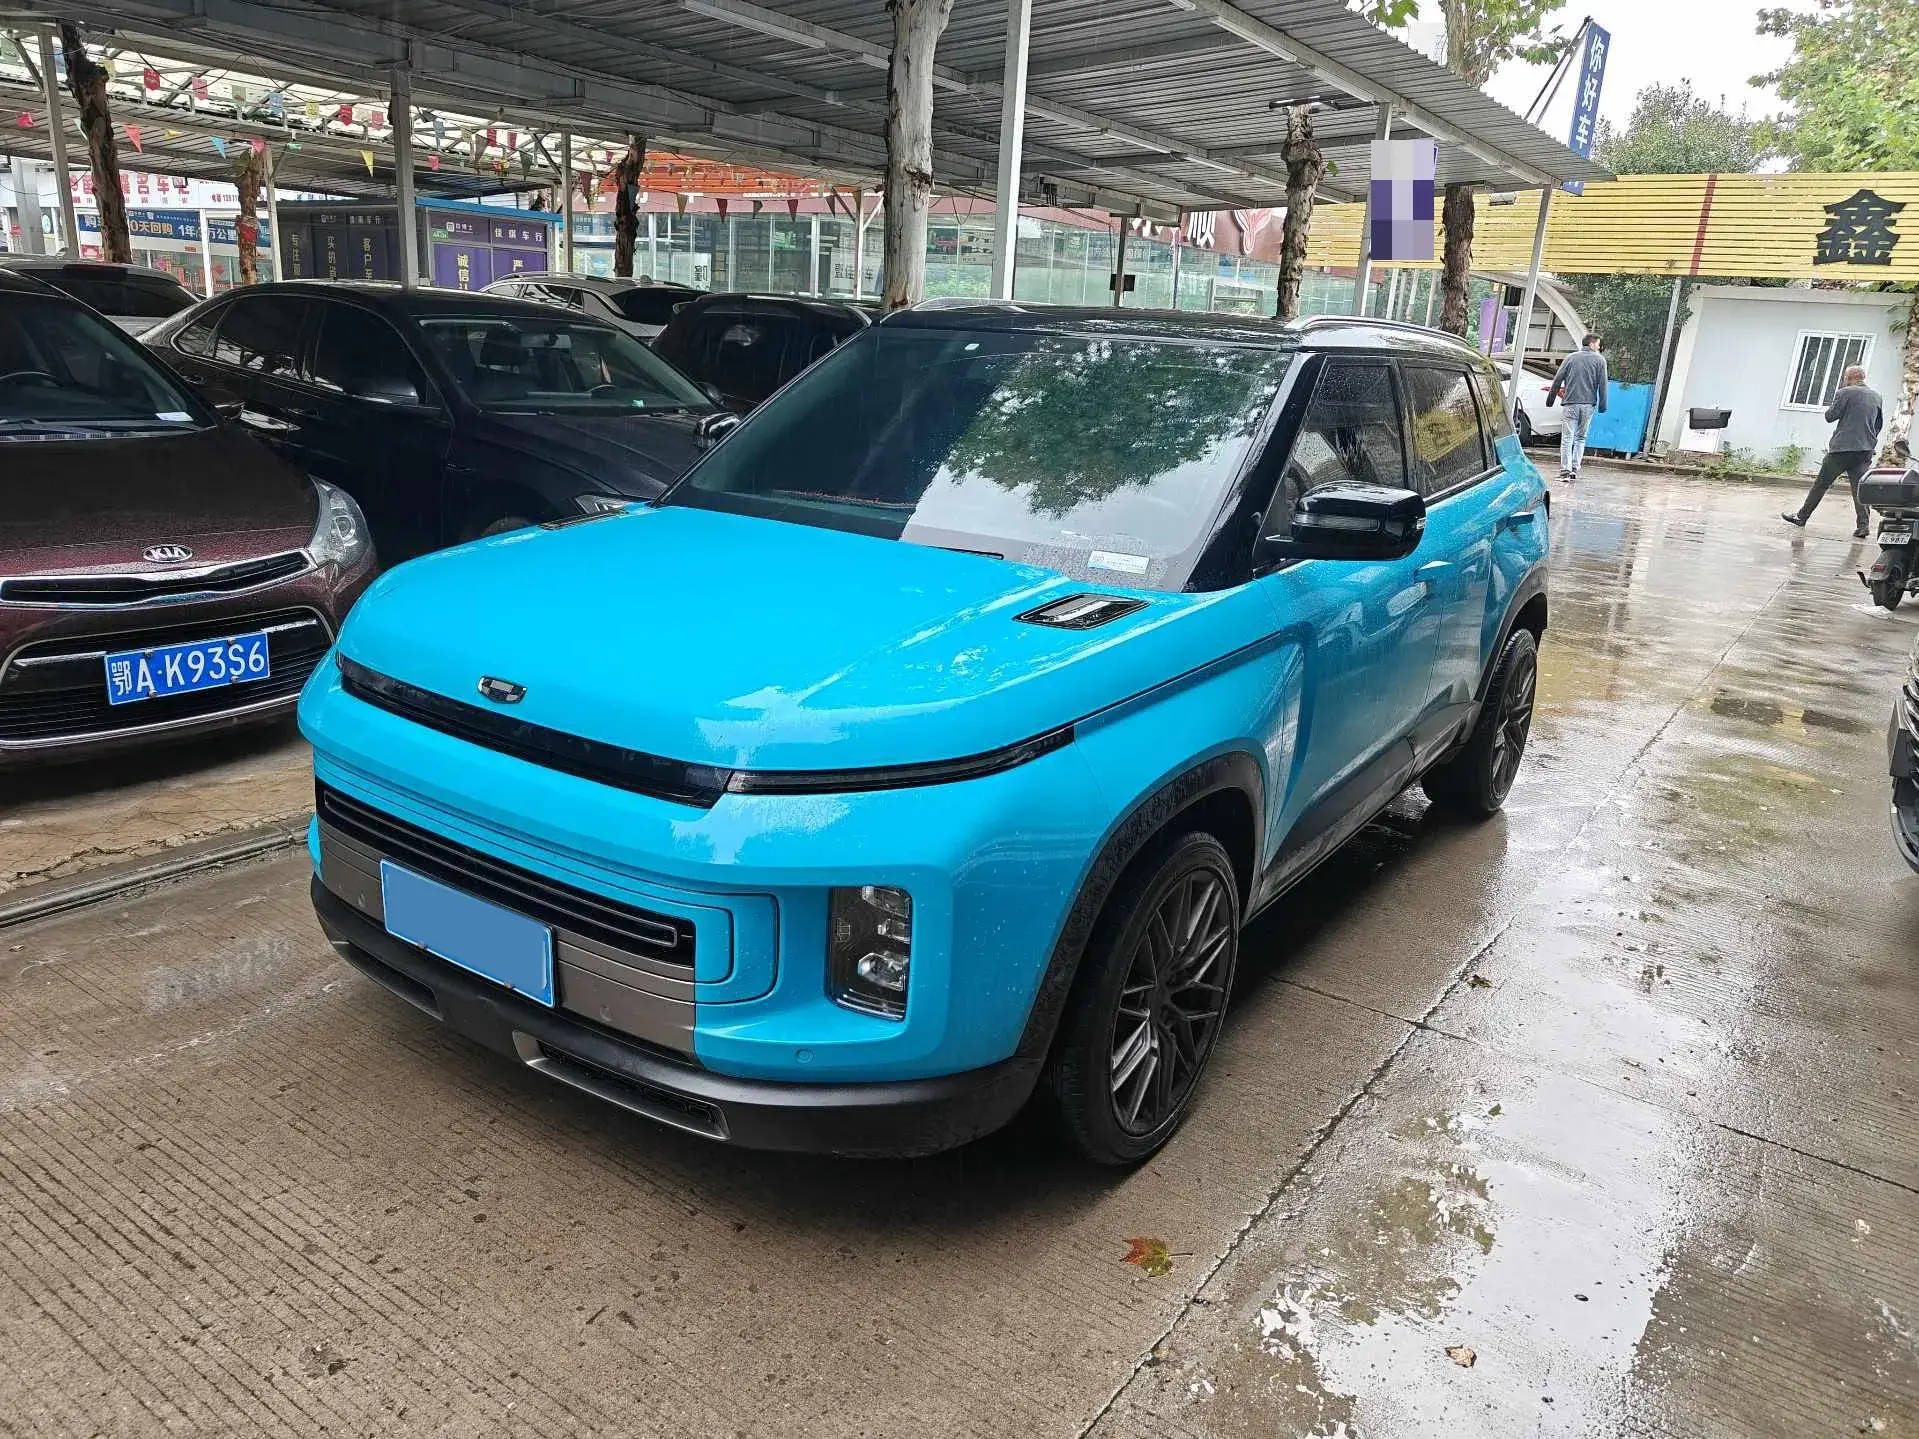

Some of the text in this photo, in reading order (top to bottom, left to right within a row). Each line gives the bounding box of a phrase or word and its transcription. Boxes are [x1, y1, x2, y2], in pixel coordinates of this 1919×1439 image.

[1575, 33, 1605, 150] 你好车
[129, 219, 173, 236] 0天回购
[1813, 189, 1907, 266] 鑫
[456, 252, 470, 290] 诚信
[150, 547, 188, 561] KIA
